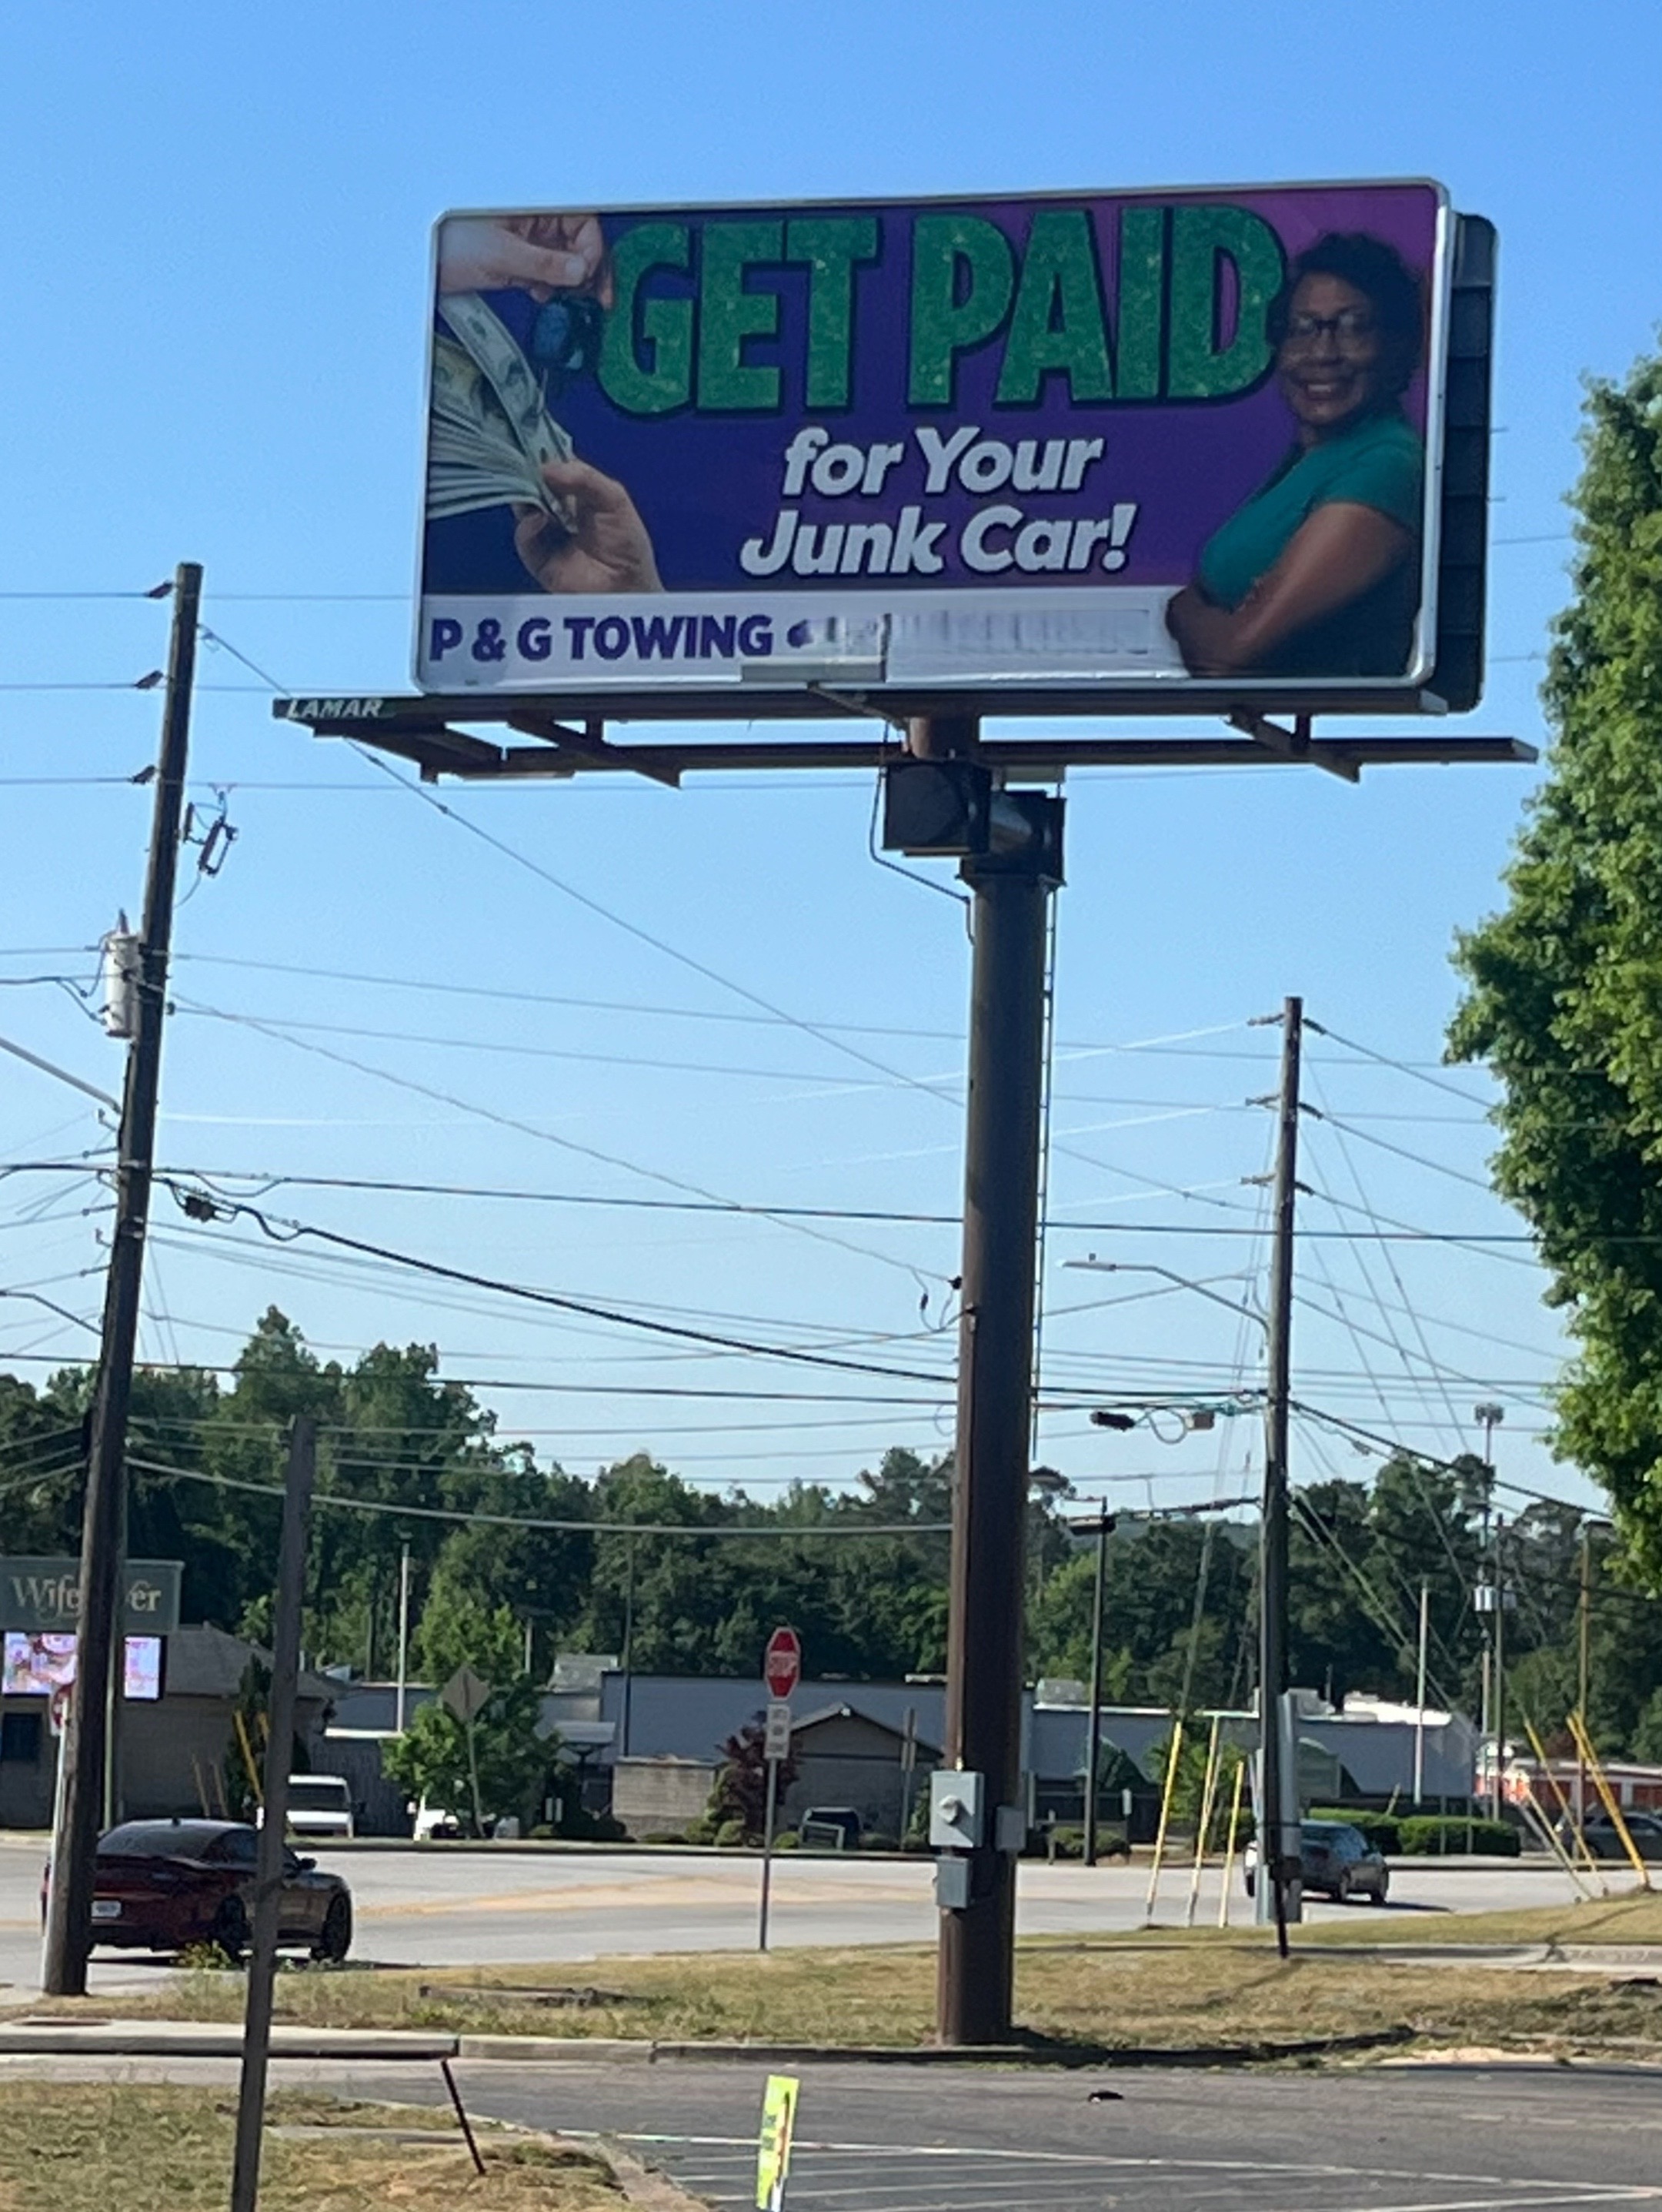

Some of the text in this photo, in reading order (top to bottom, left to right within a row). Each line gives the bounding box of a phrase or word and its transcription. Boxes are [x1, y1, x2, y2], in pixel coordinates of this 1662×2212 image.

[597, 203, 1287, 416] GET PAID
[782, 426, 1104, 496] for Your
[739, 503, 1137, 576] Junk Car!
[429, 618, 462, 662] P
[471, 618, 507, 663] &
[516, 617, 552, 662] G
[562, 614, 773, 660] TOWING
[286, 698, 384, 719] LAMAR
